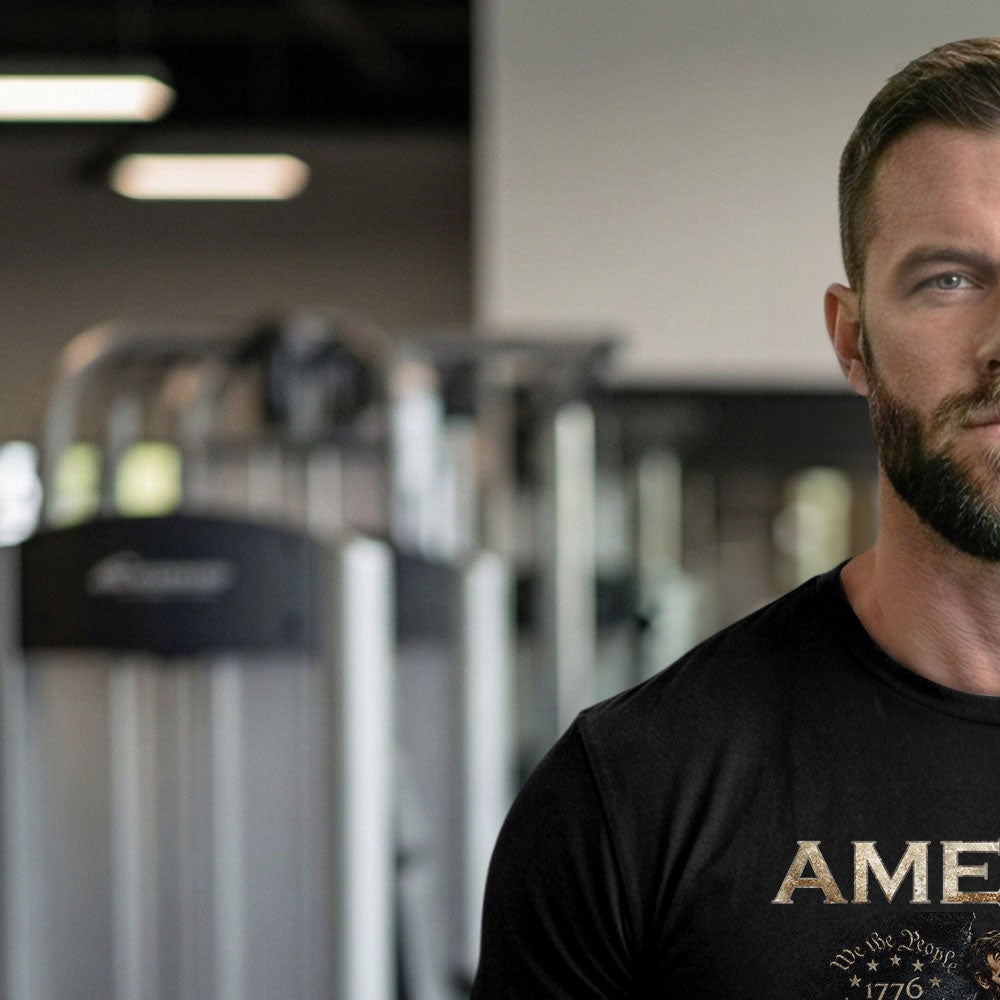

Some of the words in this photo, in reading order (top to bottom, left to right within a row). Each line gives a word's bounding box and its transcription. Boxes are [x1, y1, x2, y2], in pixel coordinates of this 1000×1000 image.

[829, 946, 865, 970] We
[865, 931, 894, 952] the
[897, 929, 957, 974] People
